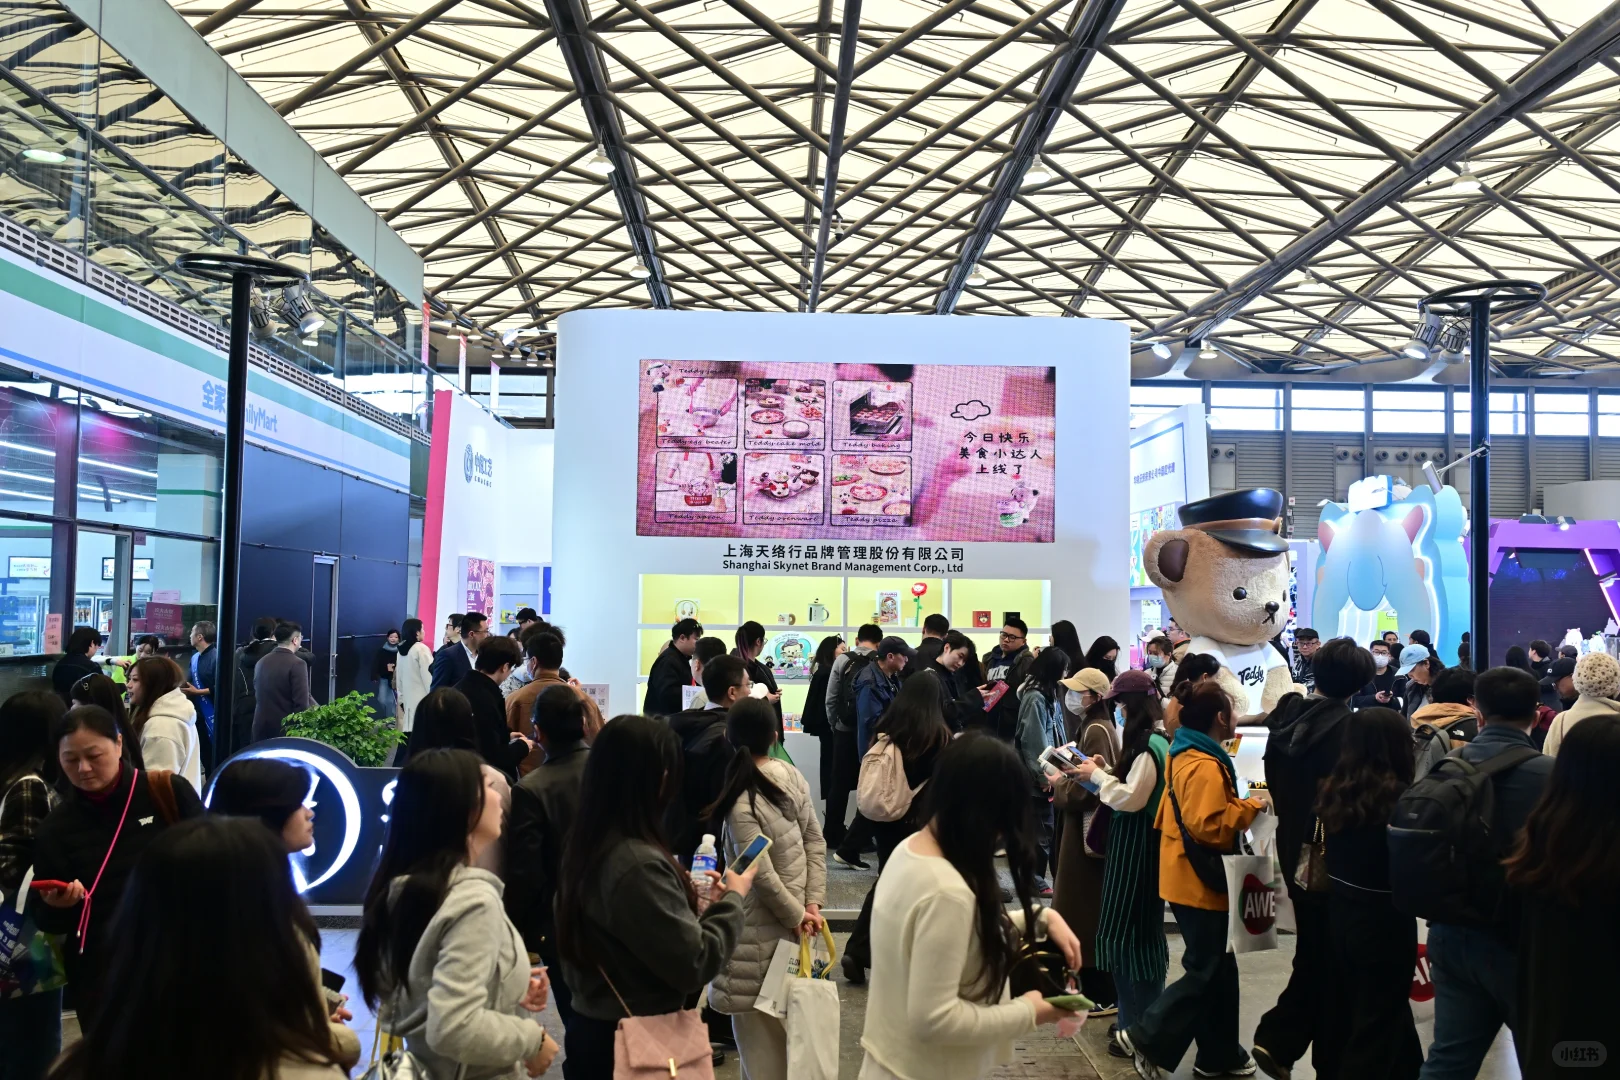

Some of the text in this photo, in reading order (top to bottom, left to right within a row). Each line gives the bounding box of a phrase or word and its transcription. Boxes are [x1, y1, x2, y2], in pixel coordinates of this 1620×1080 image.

[202, 380, 227, 413] 全家
[964, 431, 1029, 443] 今日快乐
[959, 447, 1042, 460] 美食小达人
[976, 464, 1022, 475] 上线了
[723, 544, 964, 561] 上海天络行品牌管理股份有限公司
[723, 560, 964, 574] Shanghai Skynet Brand Management Corp., Ltd
[987, 665, 1010, 681] NIK
[1238, 665, 1264, 686] Teddy
